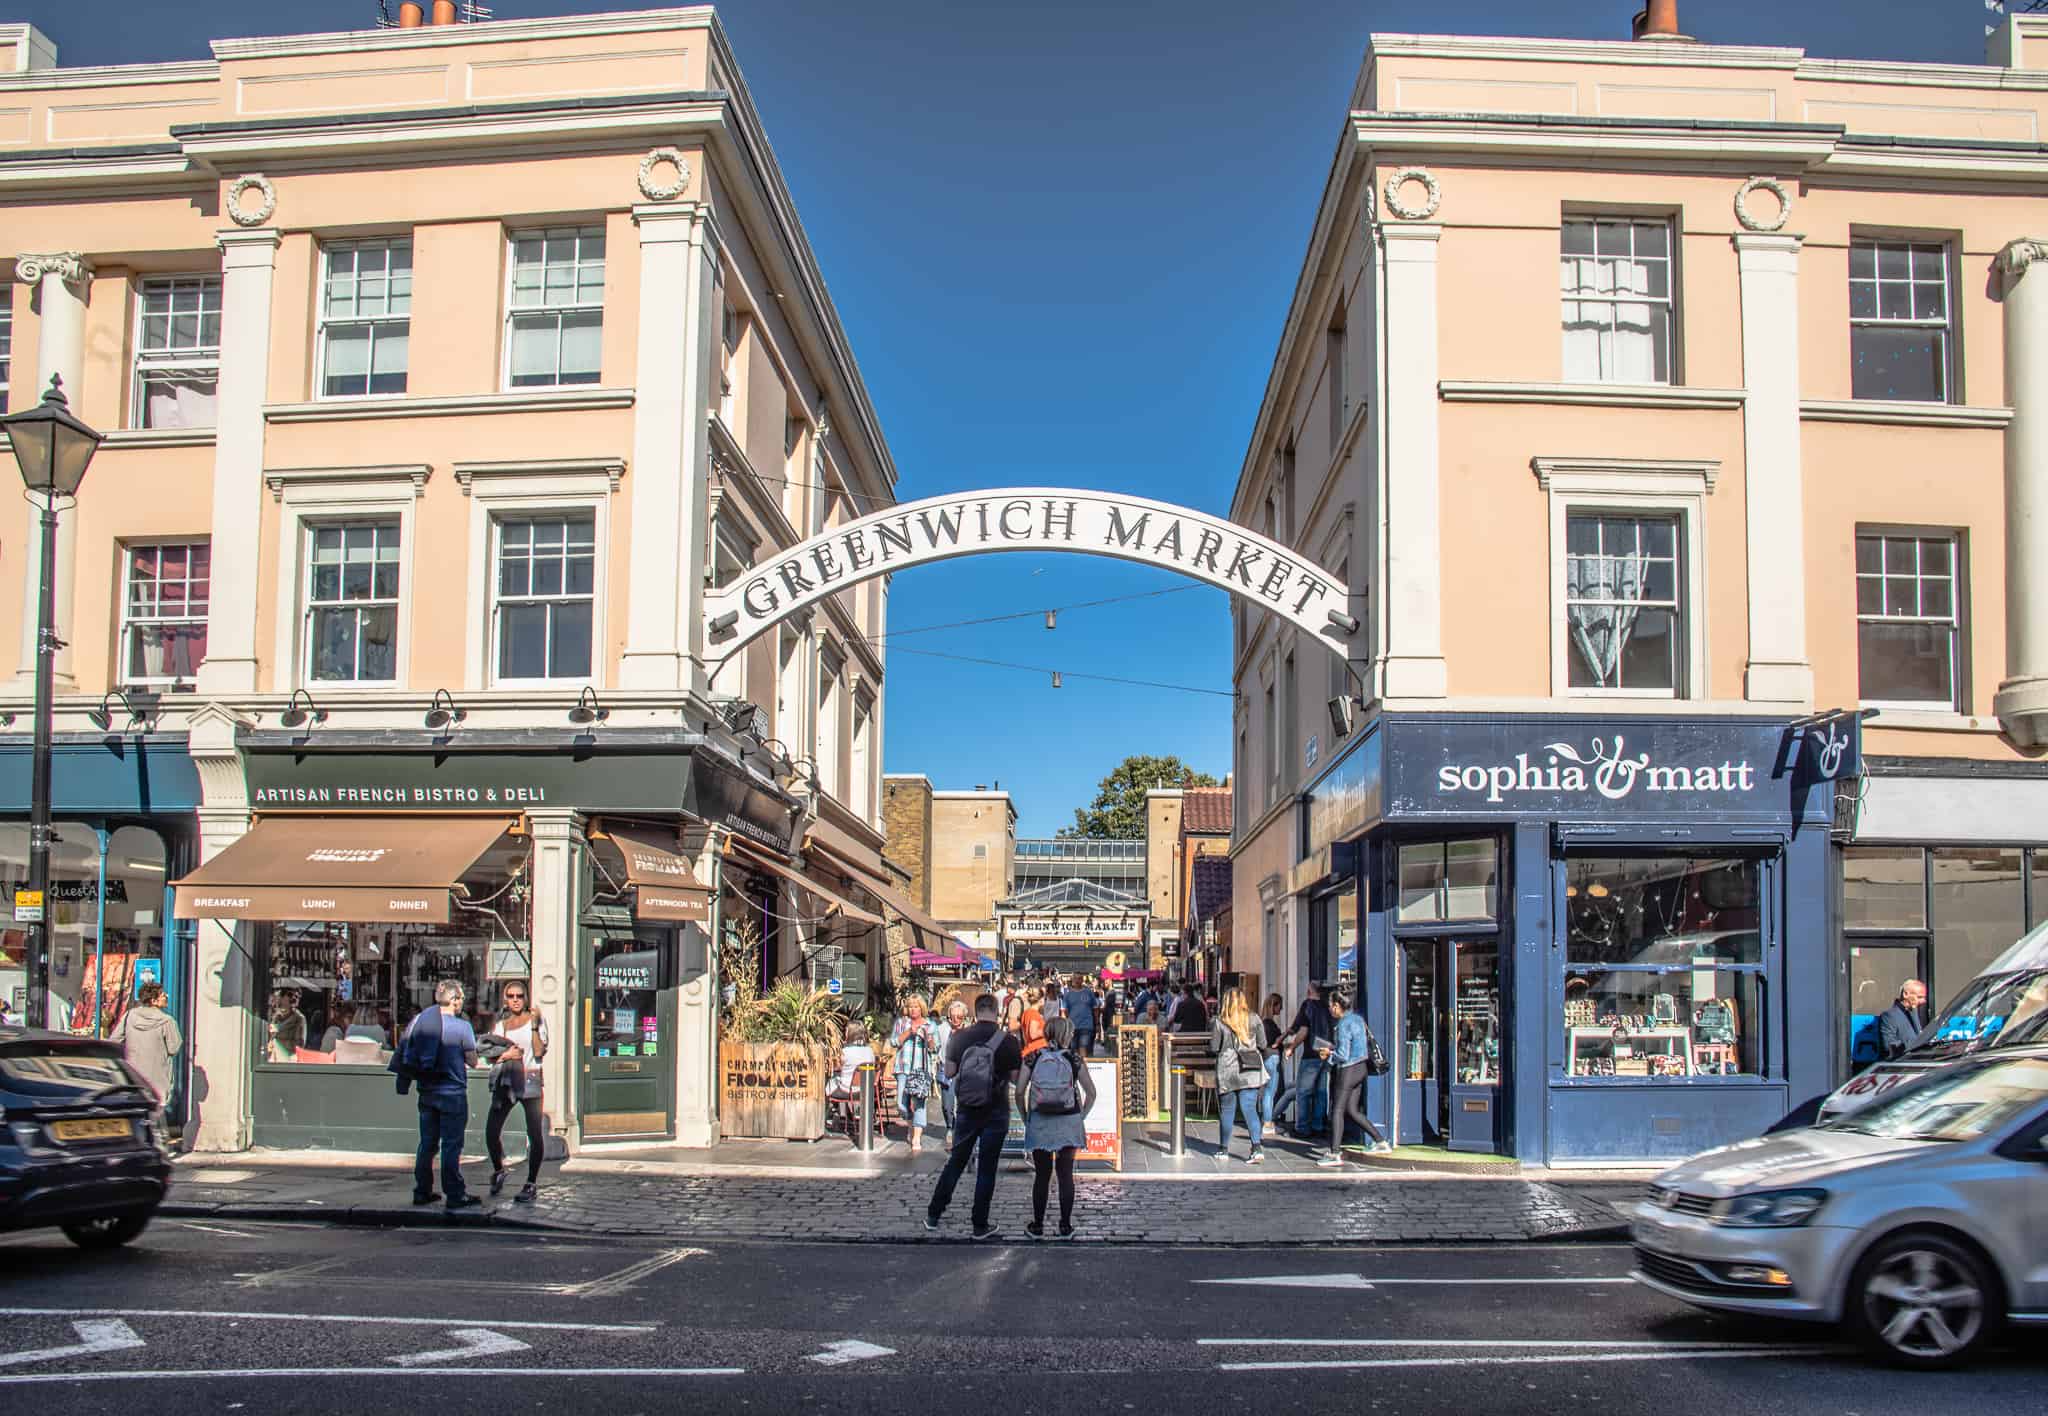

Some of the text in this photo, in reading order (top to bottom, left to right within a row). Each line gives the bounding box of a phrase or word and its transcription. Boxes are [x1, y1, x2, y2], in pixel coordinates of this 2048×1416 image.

[744, 500, 1327, 619] GREENWICH MARKET
[1439, 753, 1588, 801] sophia
[1646, 760, 1754, 791] matt
[255, 788, 545, 801] ARTISAN FRENCH BISTRO & DELI
[194, 898, 428, 910] BREAKFAST LUNCH DINNER
[1010, 922, 1136, 931] GREENWICH MARKET
[727, 1073, 807, 1088] FROMAGE
[727, 1089, 767, 1100] BISTRO
[779, 1090, 809, 1100] SHOP
